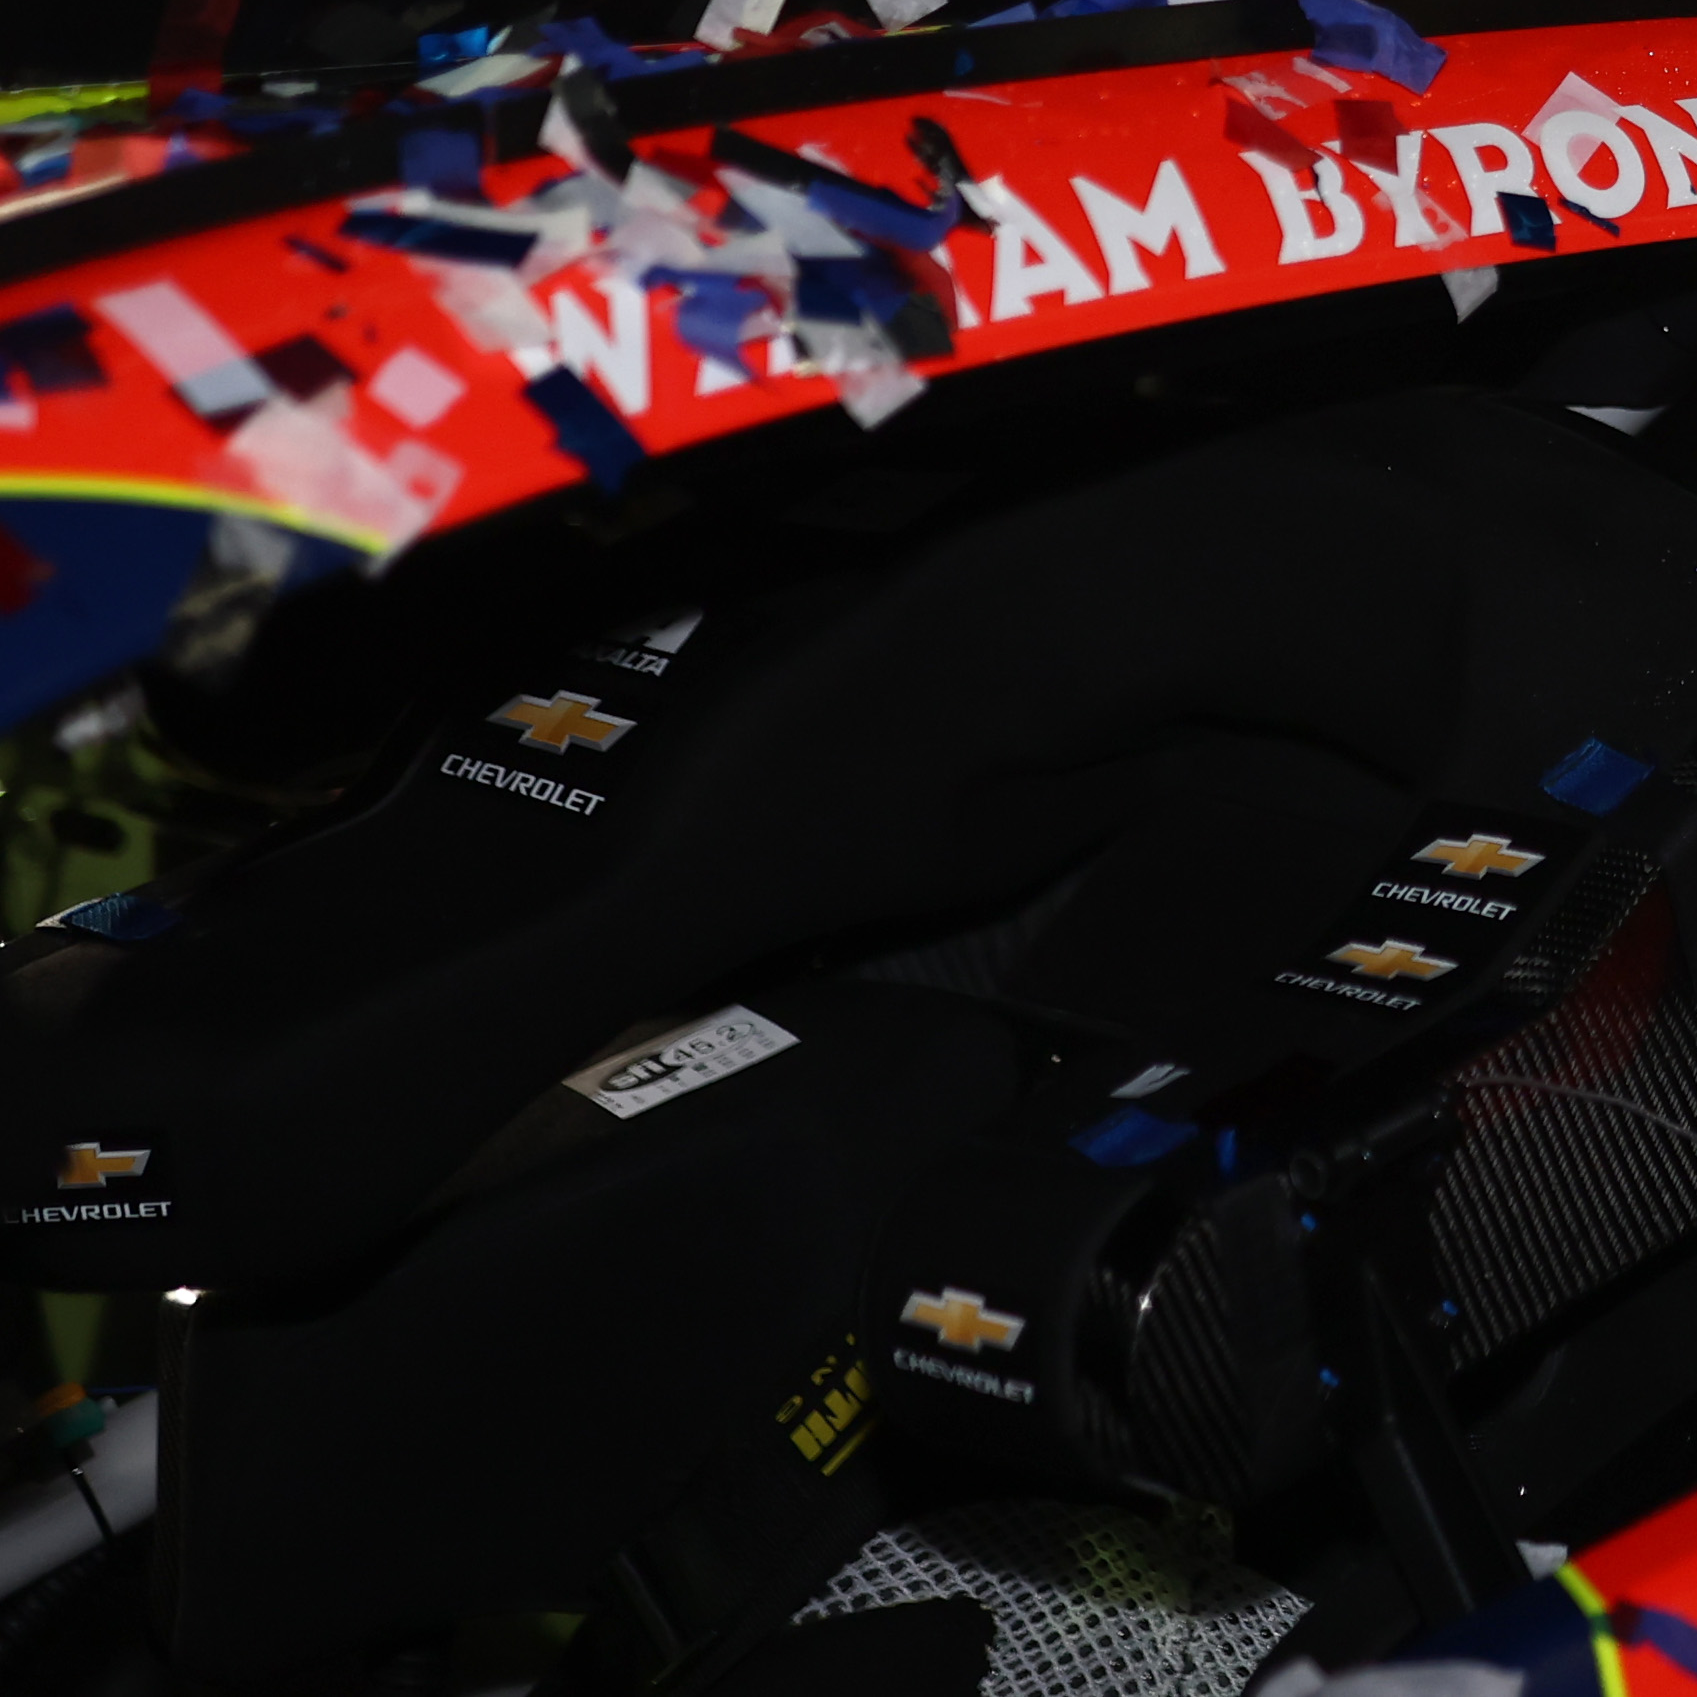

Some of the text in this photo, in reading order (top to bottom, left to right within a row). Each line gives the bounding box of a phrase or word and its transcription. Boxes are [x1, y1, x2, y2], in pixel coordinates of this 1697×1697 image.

[441, 752, 606, 816] CHEVROLET
[1371, 881, 1517, 922] CHEVROLET
[1274, 971, 1422, 1011] CHEVROLET
[893, 1347, 1035, 1406] CHEVROLET
